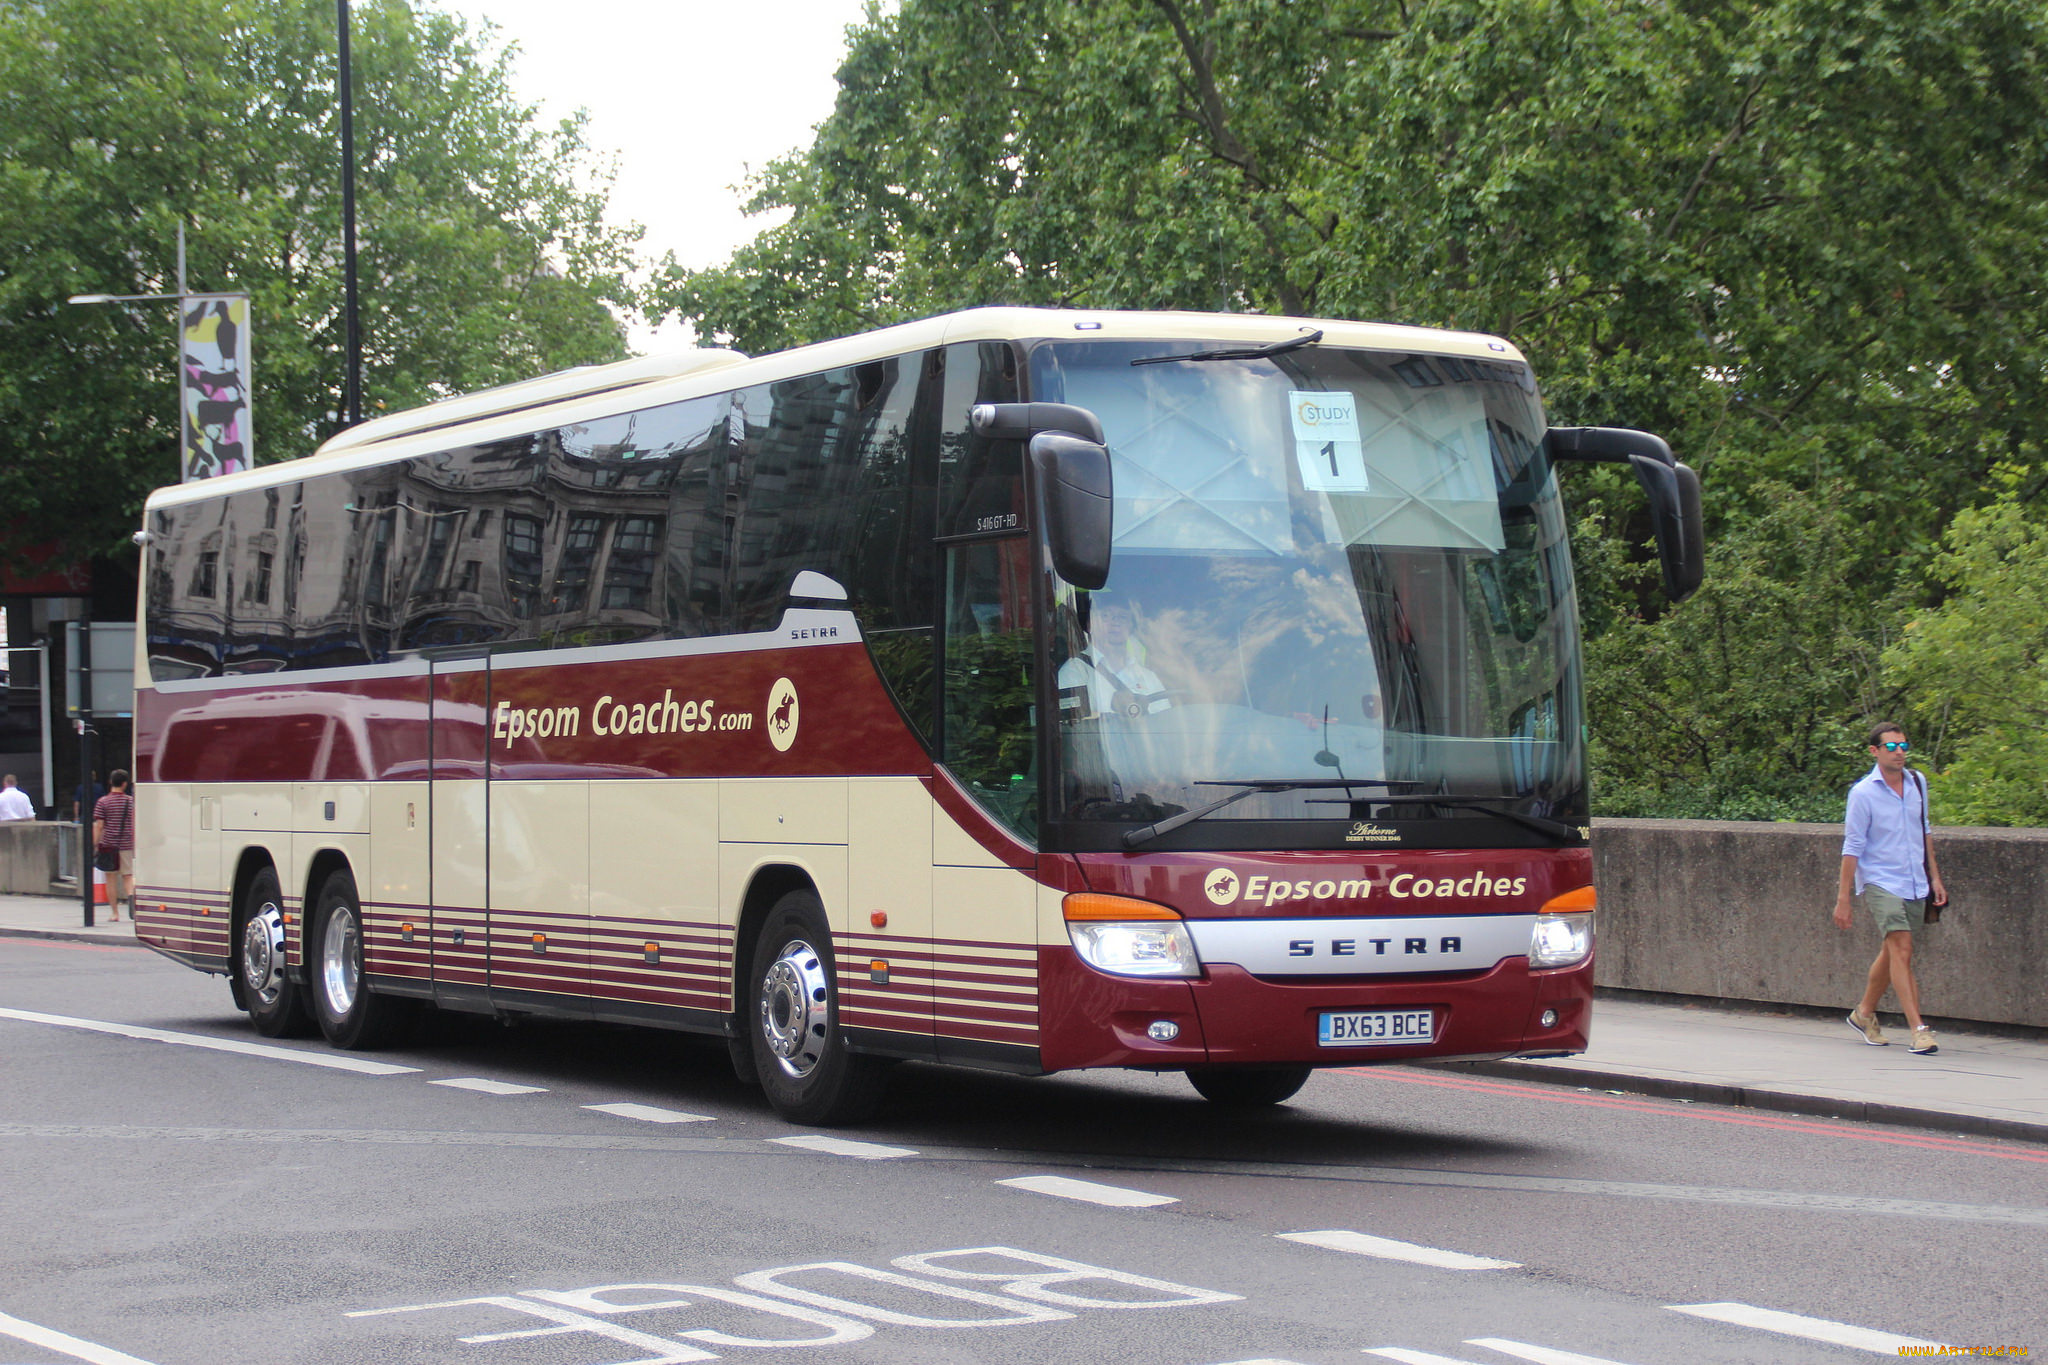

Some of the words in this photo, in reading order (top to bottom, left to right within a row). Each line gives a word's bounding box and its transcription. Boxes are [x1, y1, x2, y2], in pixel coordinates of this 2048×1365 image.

[1308, 407, 1350, 419] STUDY
[1320, 440, 1339, 477] 1
[791, 626, 838, 640] SETRA
[493, 700, 580, 749] Epsom
[1350, 822, 1397, 835] Airborne
[1243, 874, 1372, 907] Epsom
[1388, 870, 1527, 899] Coaches
[1288, 935, 1462, 957] SETRA
[1333, 1014, 1386, 1039] BX63
[1392, 1013, 1430, 1037] BCE
